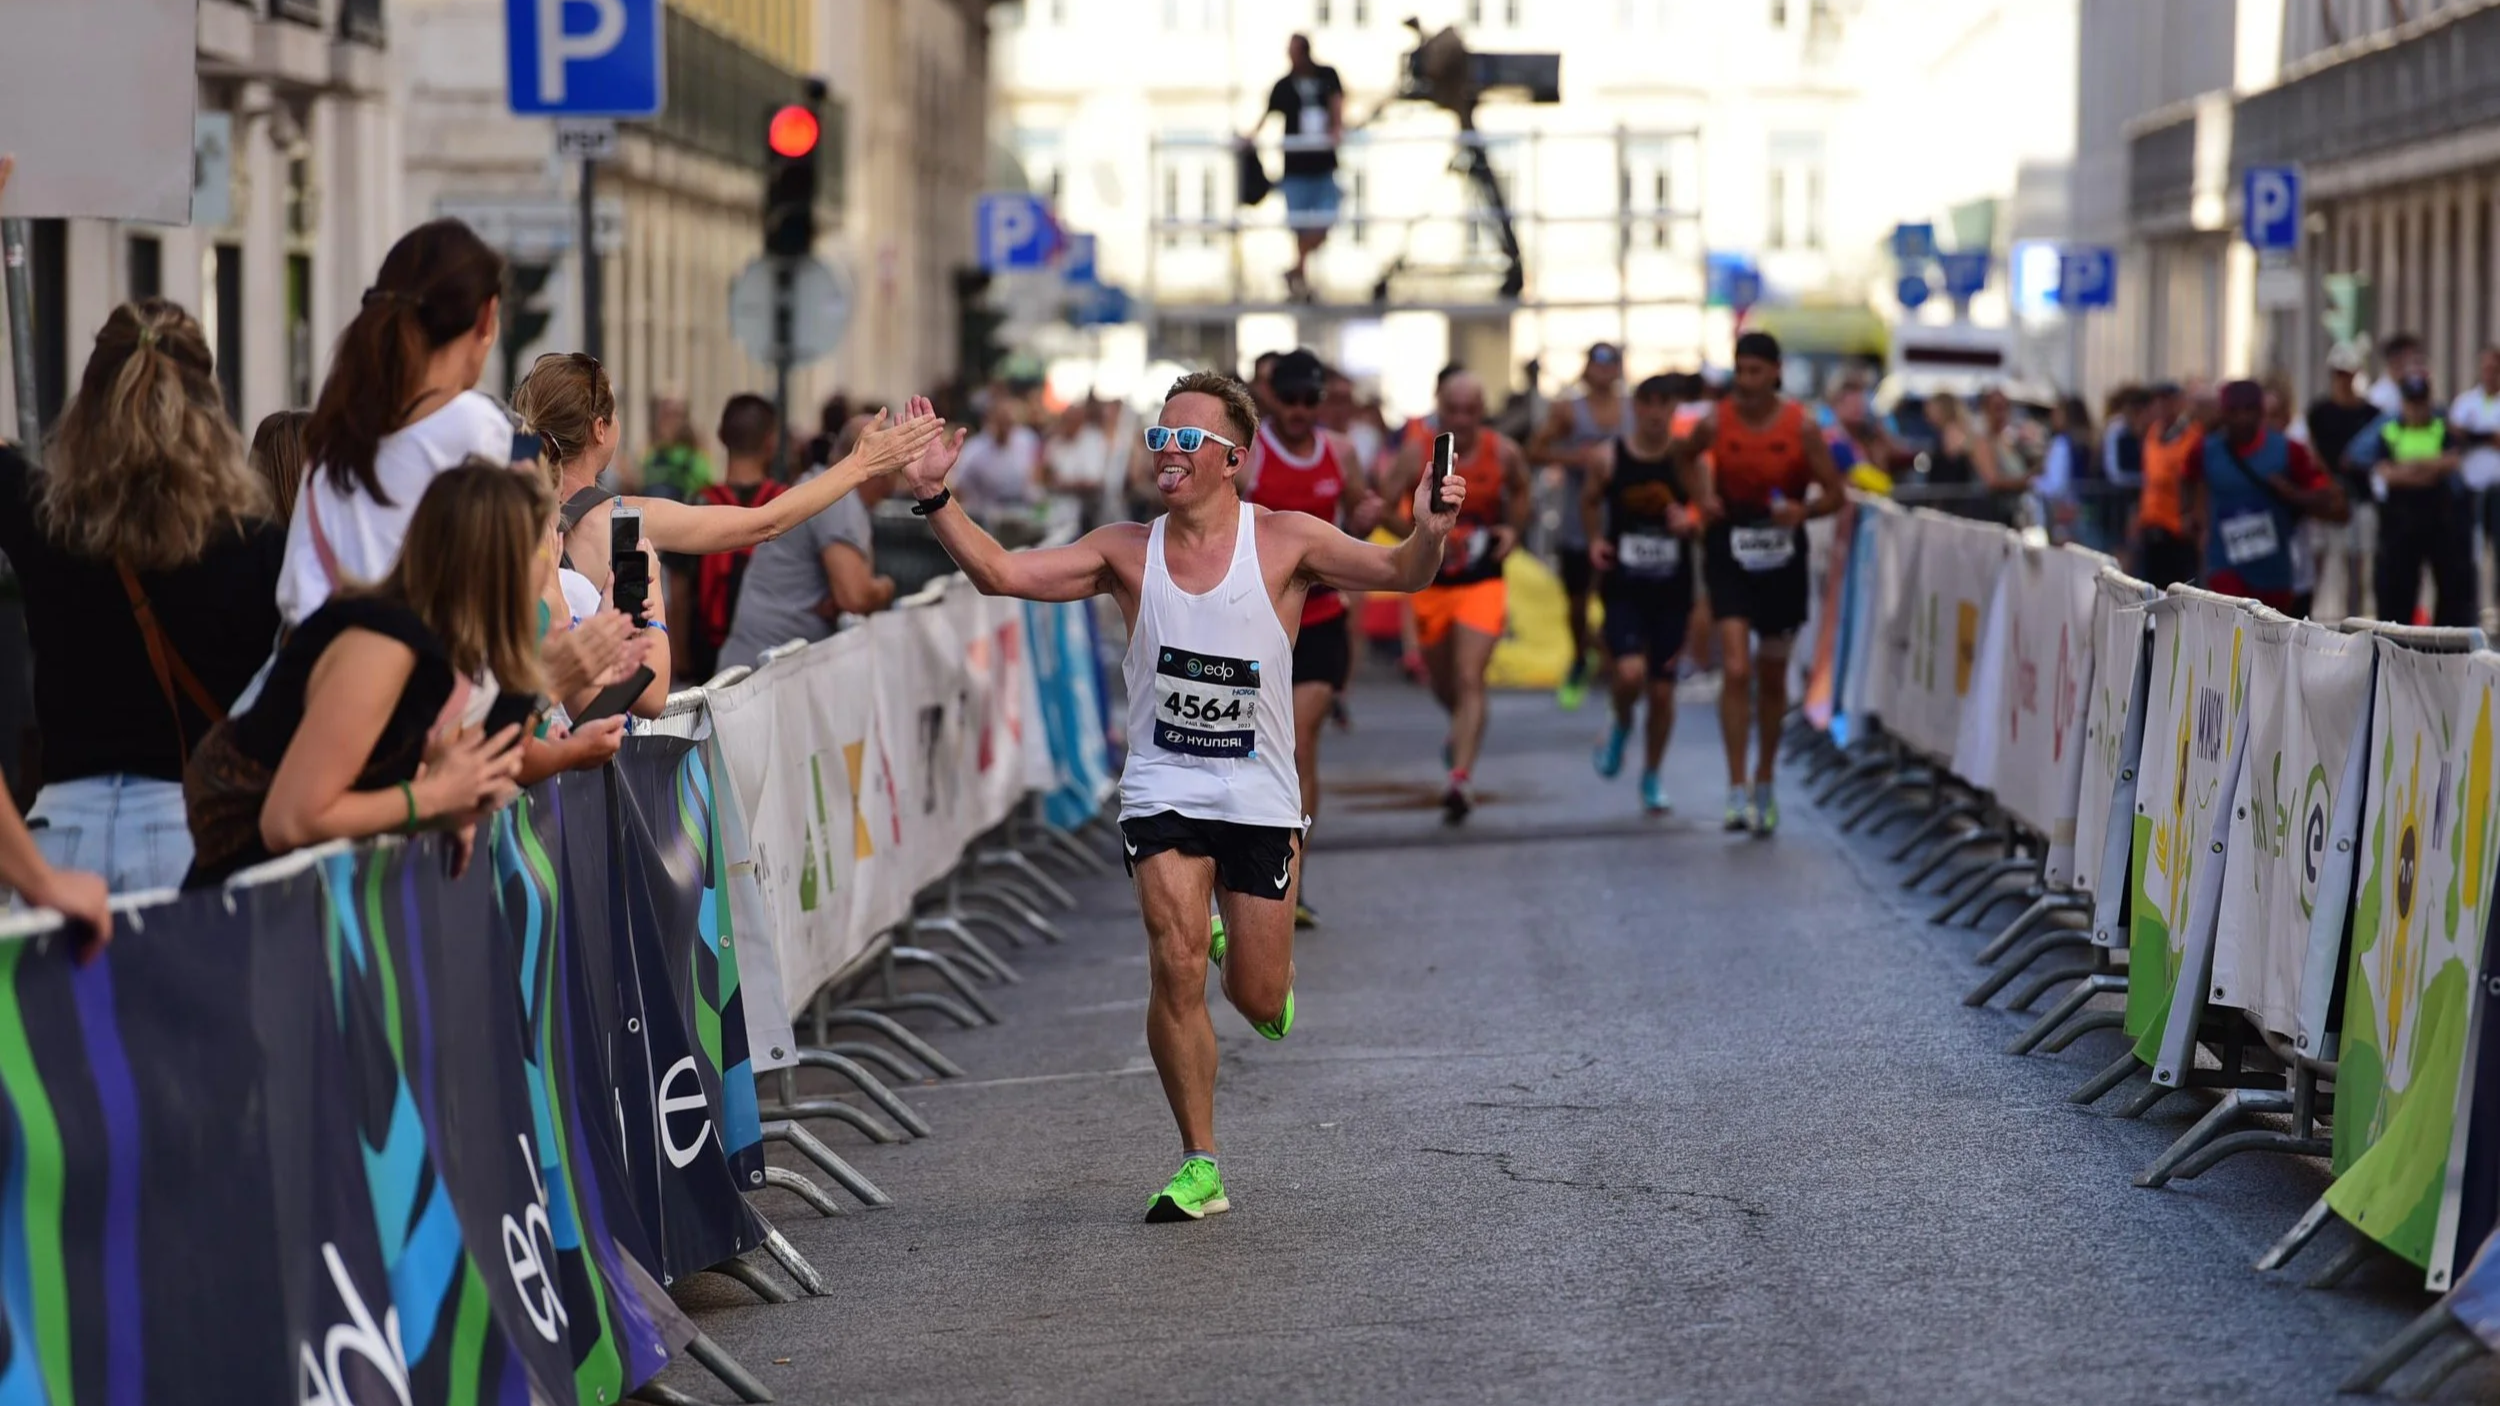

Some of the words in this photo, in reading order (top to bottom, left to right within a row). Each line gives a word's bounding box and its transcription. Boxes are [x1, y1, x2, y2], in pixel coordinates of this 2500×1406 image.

[536, 0, 627, 104] P
[990, 199, 1035, 264] P
[2253, 171, 2290, 240] P
[2065, 252, 2103, 303] P
[1204, 661, 1234, 682] edp
[1164, 692, 1241, 721] 4564
[1187, 735, 1241, 747] HYUNDAI
[502, 1133, 569, 1343] ed
